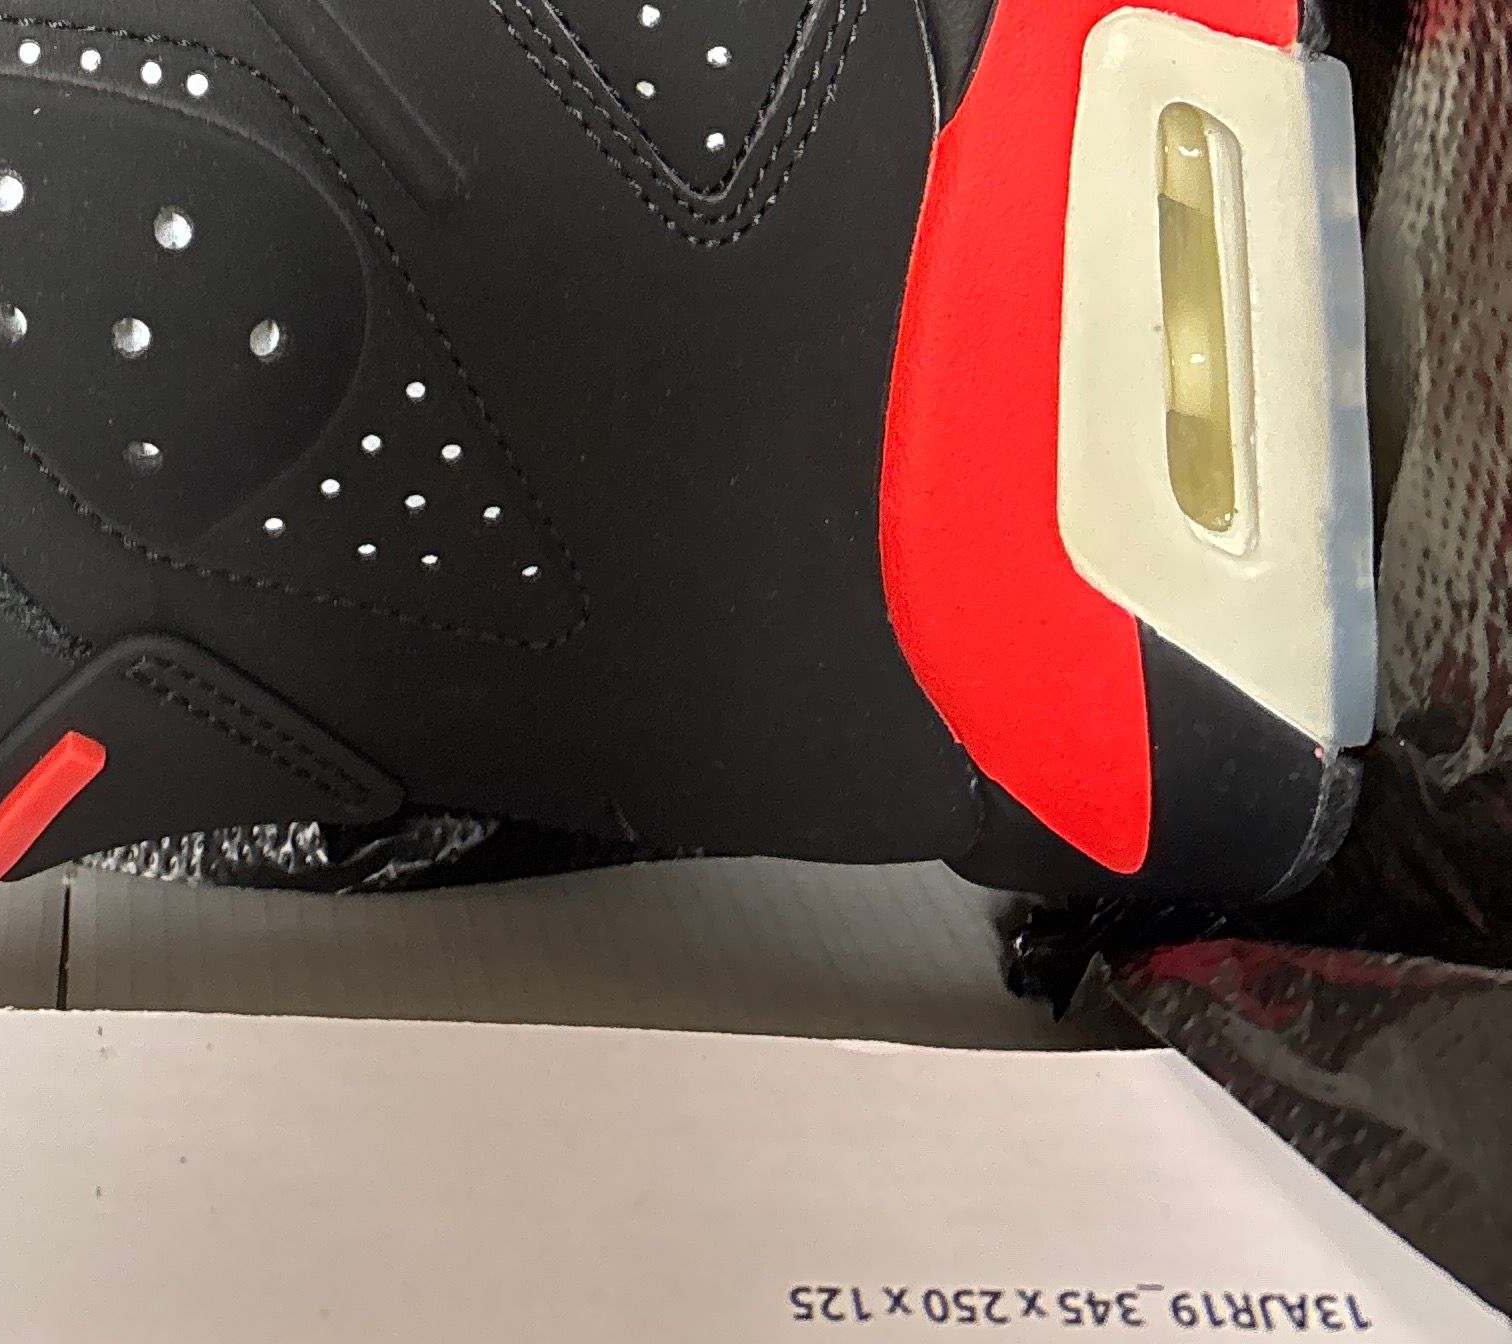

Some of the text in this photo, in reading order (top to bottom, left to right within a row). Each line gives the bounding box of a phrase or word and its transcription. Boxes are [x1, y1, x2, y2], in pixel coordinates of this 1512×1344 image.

[789, 1283, 1374, 1334] 13AJR19_345 x 250 x 125
